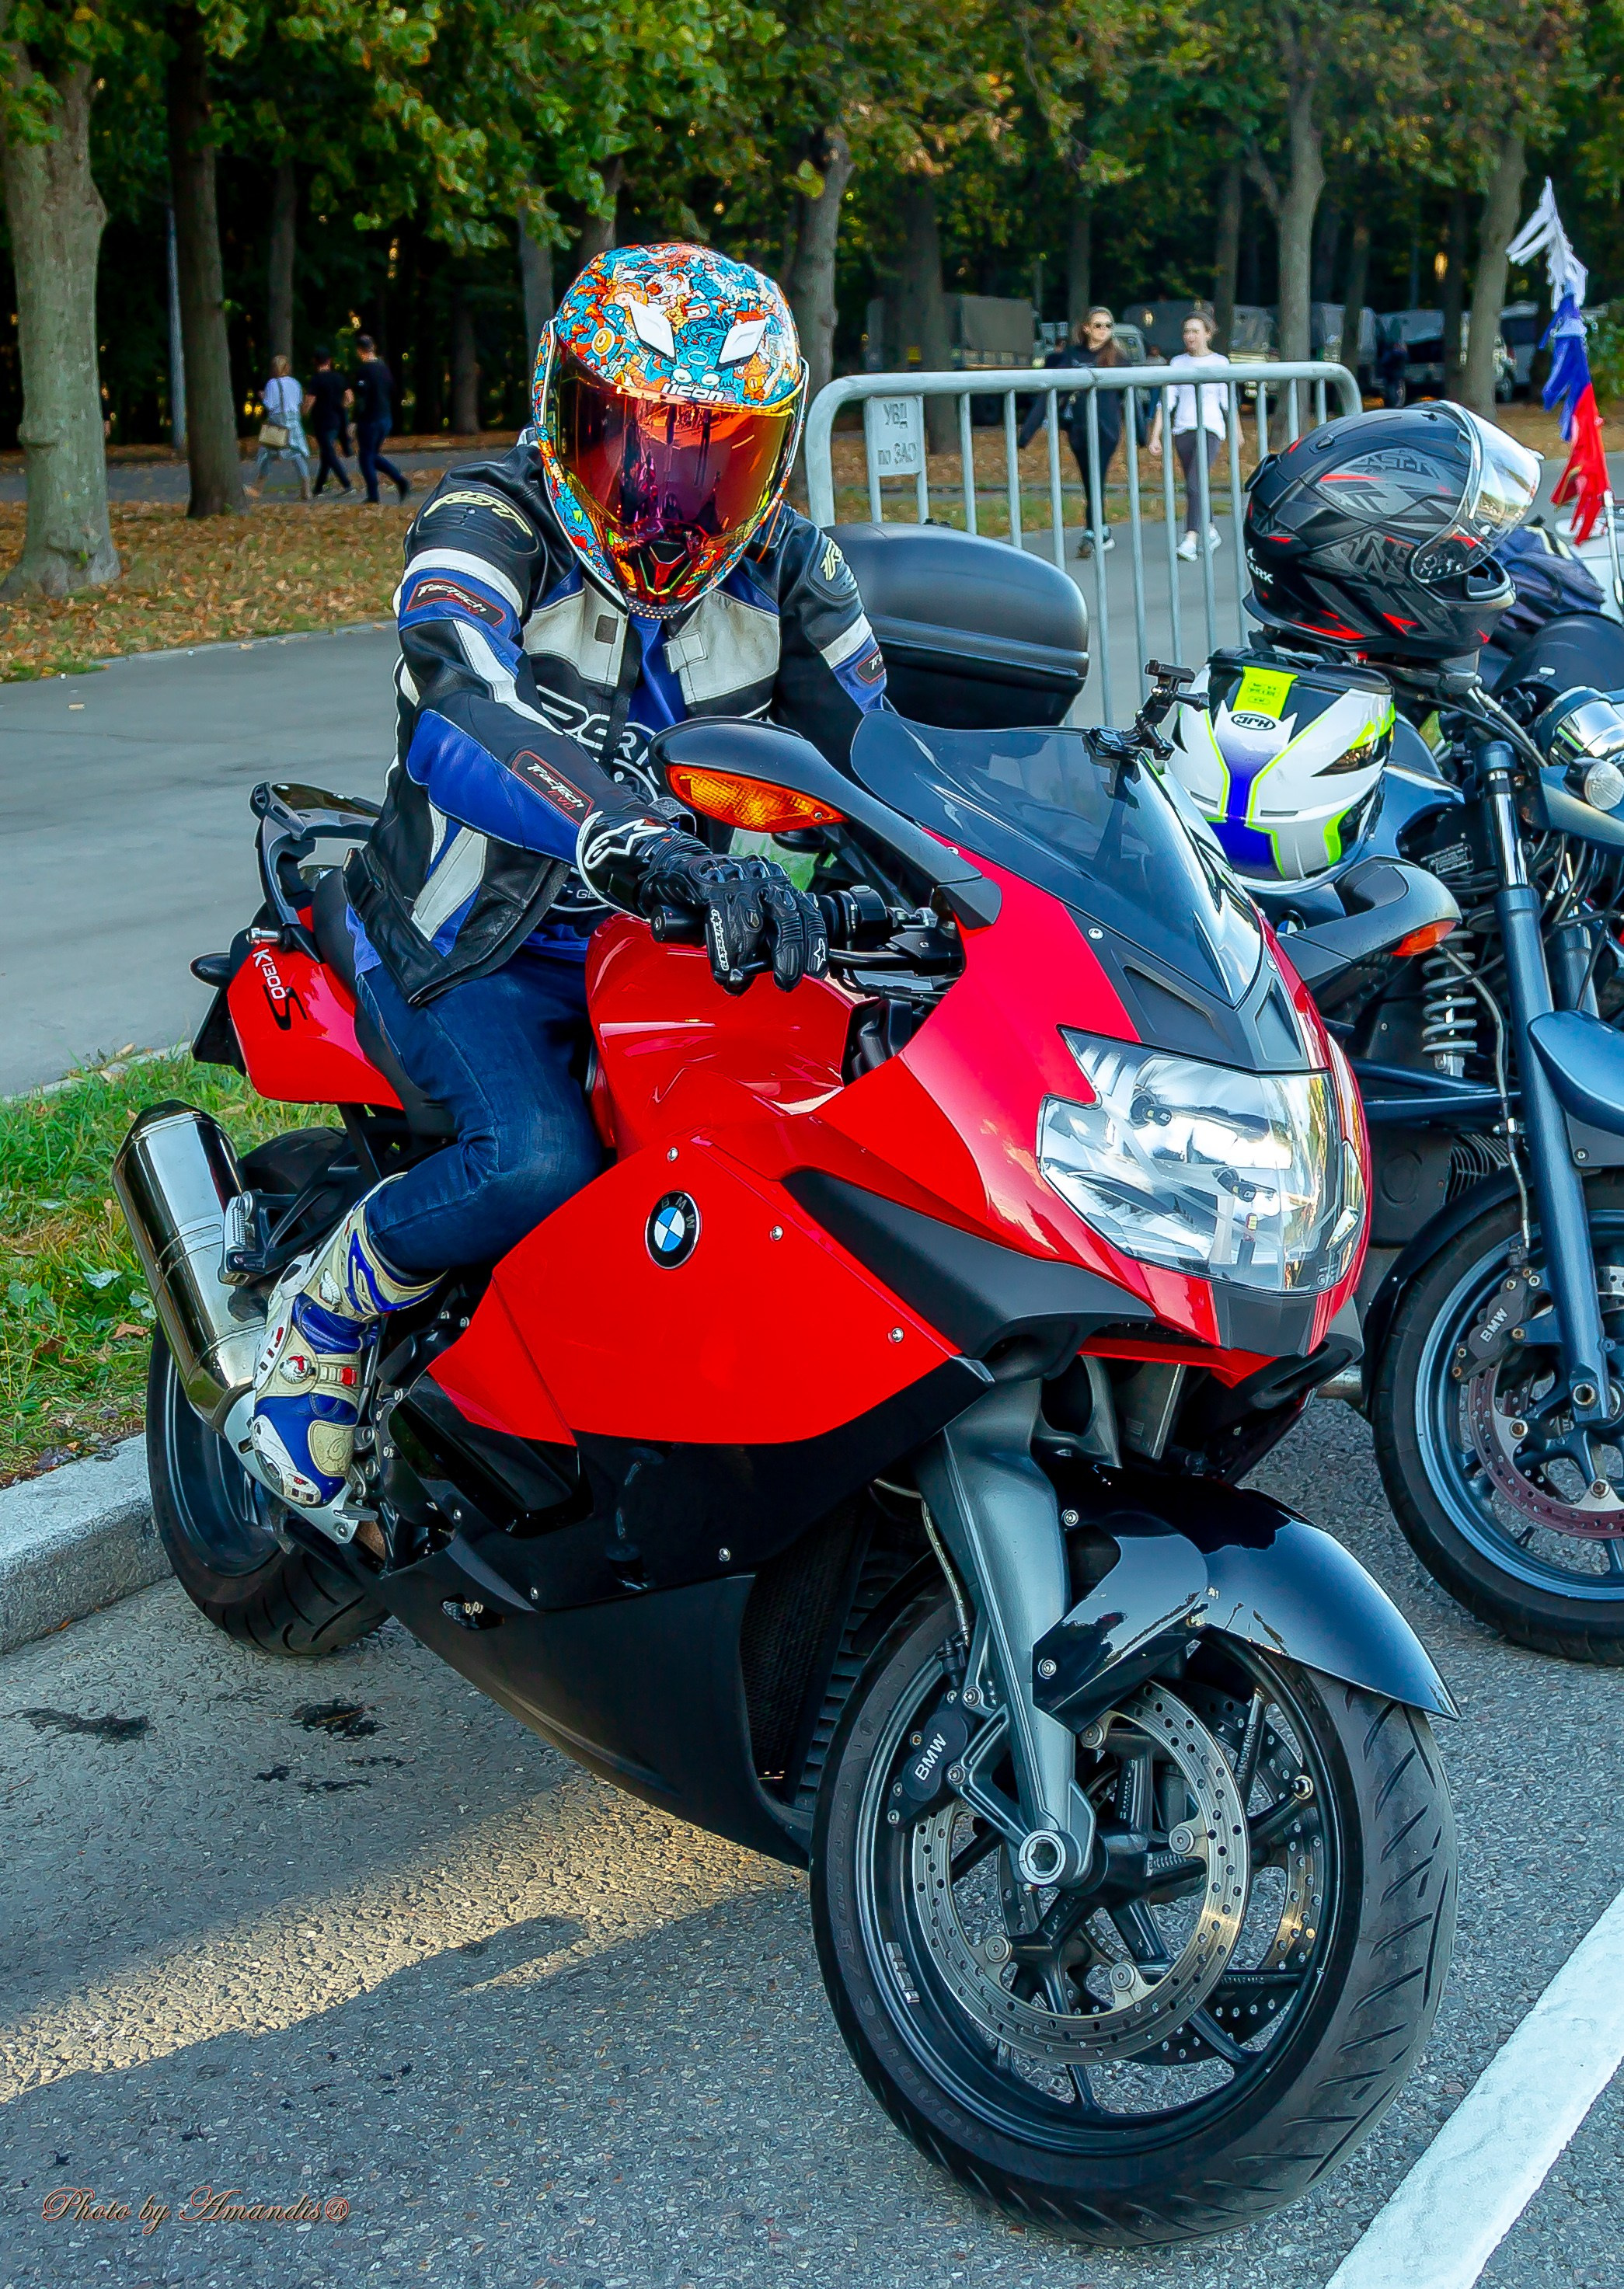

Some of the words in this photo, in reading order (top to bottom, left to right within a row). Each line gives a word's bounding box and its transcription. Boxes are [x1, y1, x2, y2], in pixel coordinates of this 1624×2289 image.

[1246, 559, 1274, 585] ARK
[1235, 715, 1271, 729] HJC
[660, 1196, 696, 1229] BMW
[1479, 1307, 1508, 1343] BMW
[915, 1733, 947, 1781] BMW
